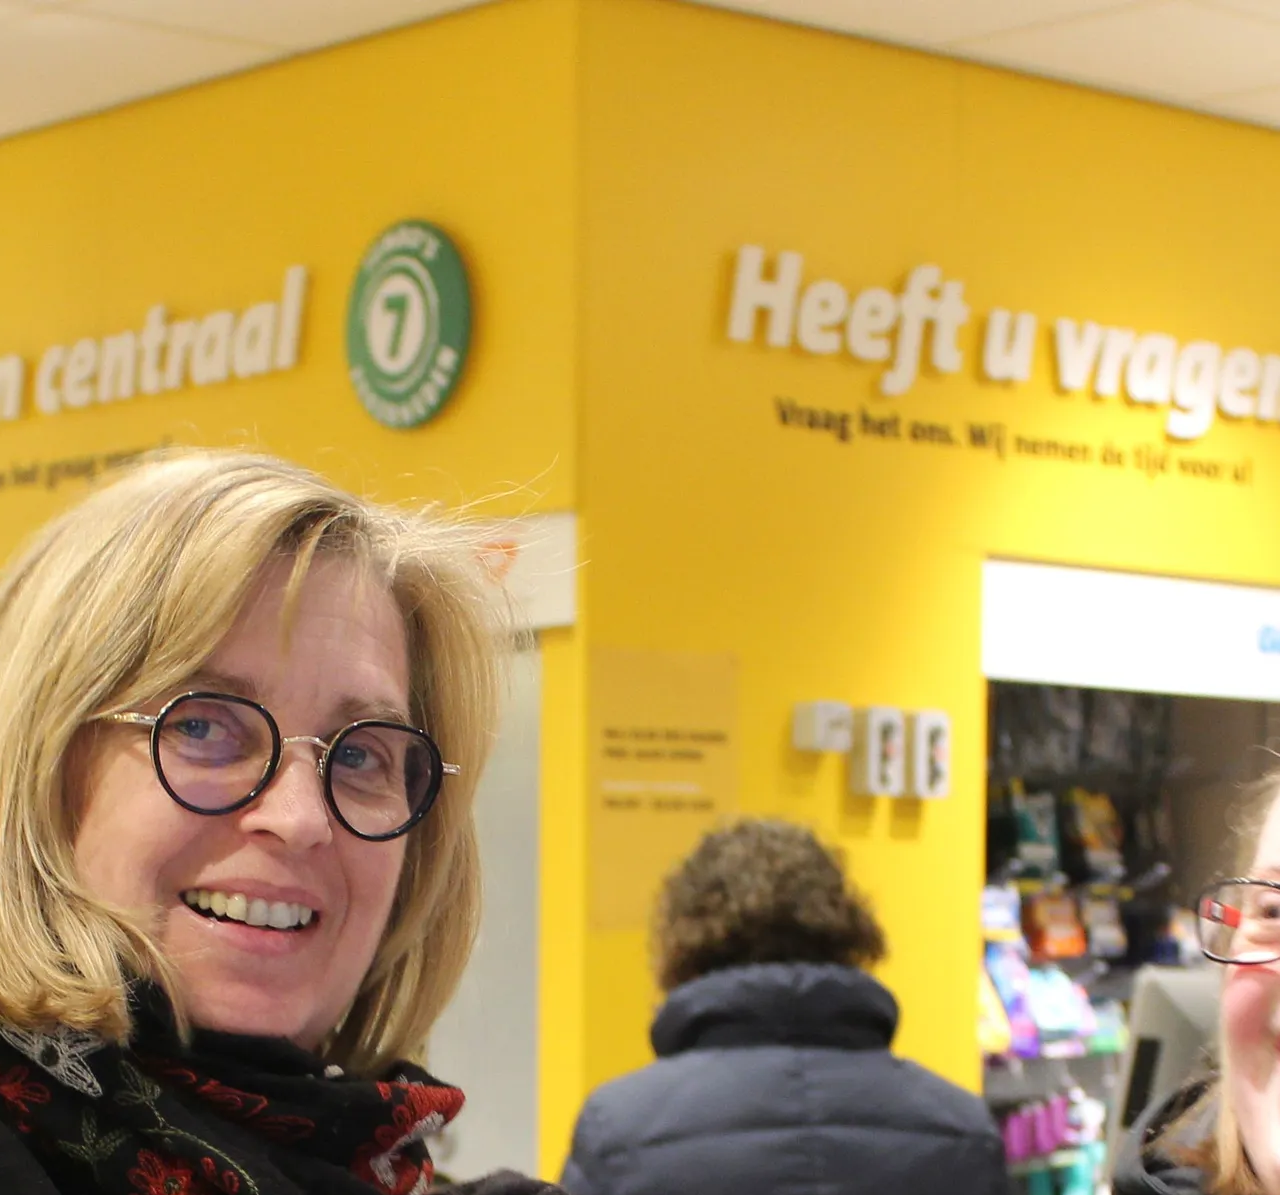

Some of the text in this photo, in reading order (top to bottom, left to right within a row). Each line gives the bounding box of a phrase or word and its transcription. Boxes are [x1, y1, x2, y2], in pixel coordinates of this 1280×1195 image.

[33, 263, 307, 415] centraal
[383, 292, 410, 362] 7
[725, 241, 971, 397] Heeft
[982, 306, 1038, 382] u
[775, 397, 852, 444] Vraag
[859, 404, 901, 438] het
